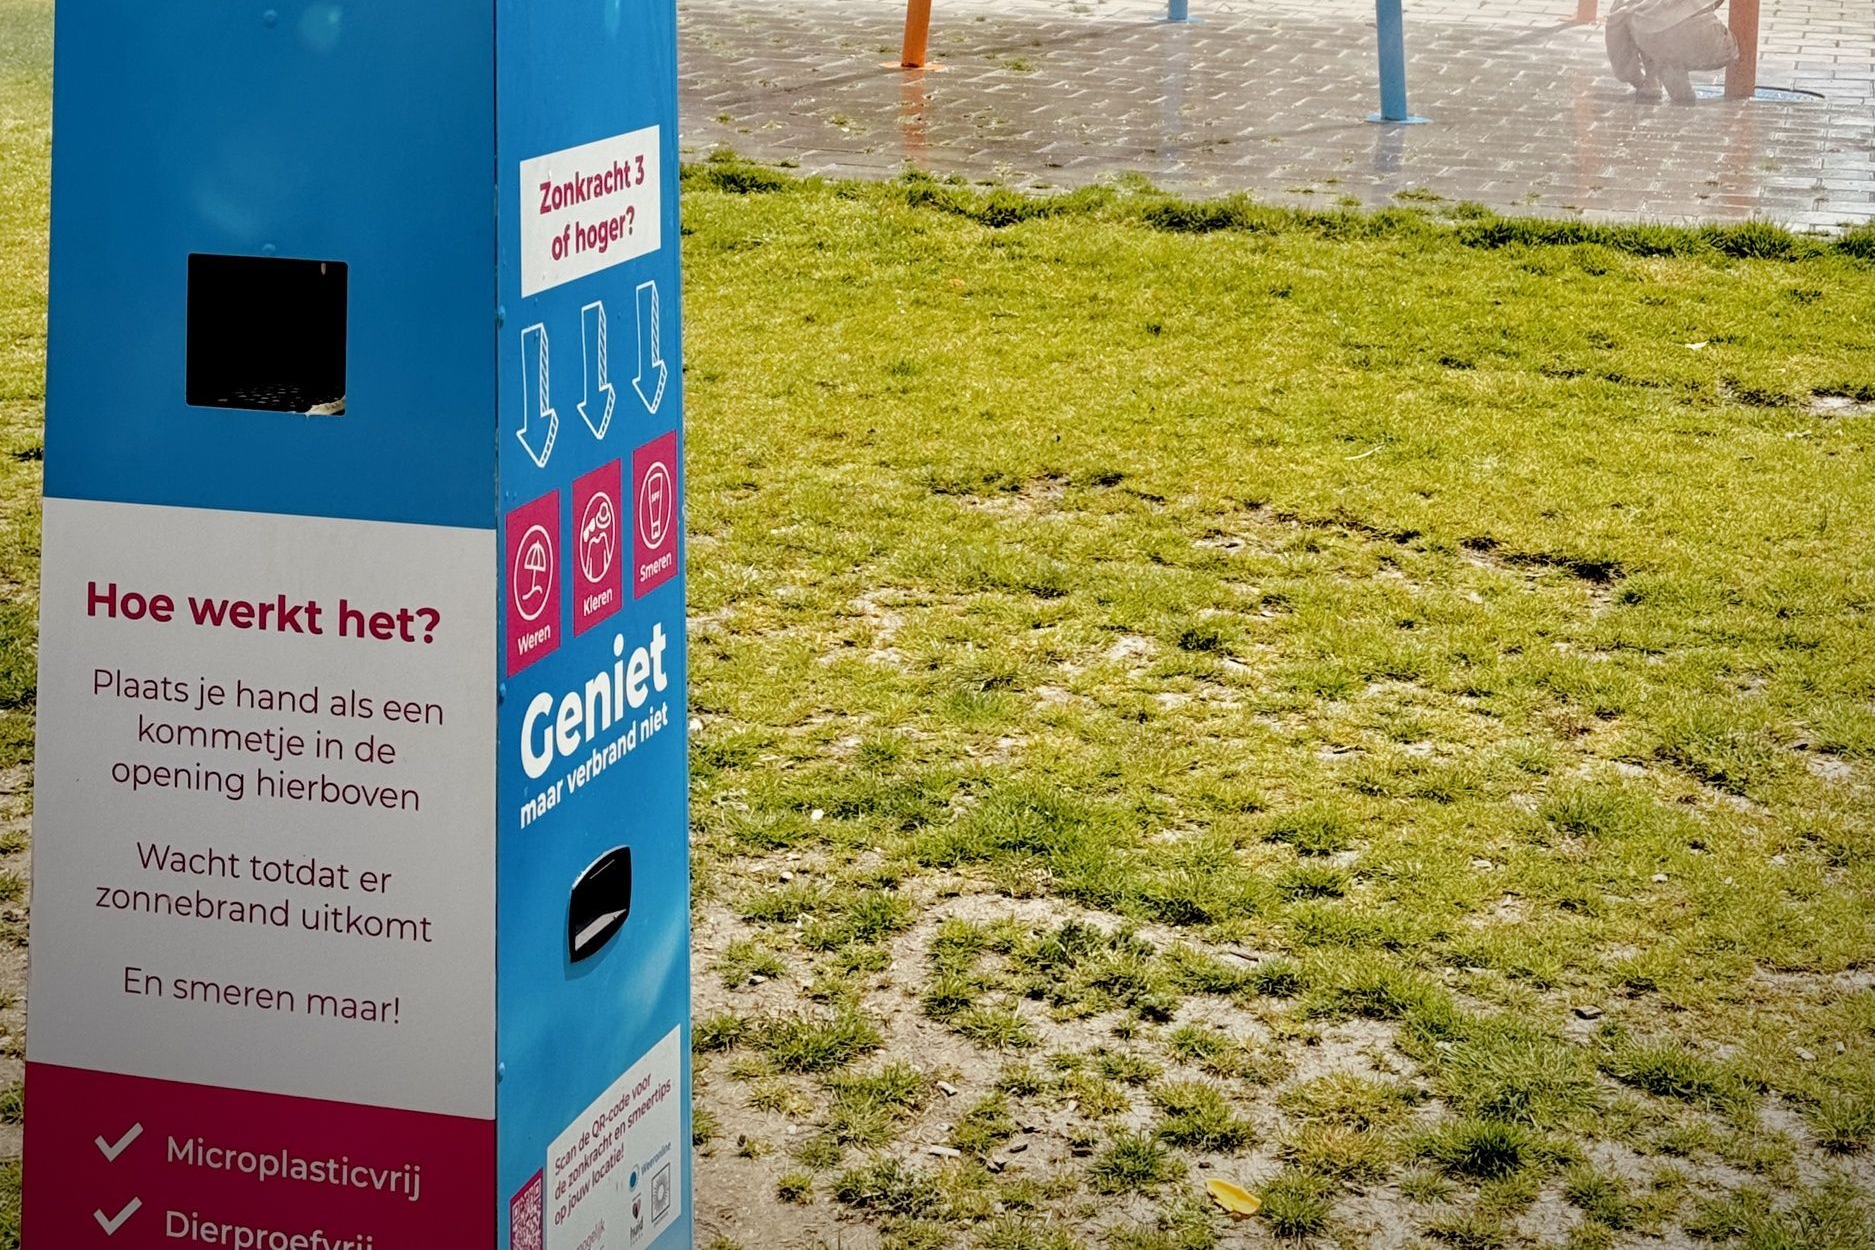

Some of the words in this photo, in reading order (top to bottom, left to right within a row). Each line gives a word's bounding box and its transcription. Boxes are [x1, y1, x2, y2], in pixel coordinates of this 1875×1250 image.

[540, 160, 631, 214] Zonkracht
[635, 154, 645, 186] 3
[551, 224, 571, 261] of
[576, 205, 635, 253] hoger?
[640, 552, 672, 583] Smeren
[87, 581, 174, 622] Hoe
[188, 594, 323, 635] werkt
[339, 599, 441, 644] het?
[583, 587, 613, 616] Kleren
[518, 624, 551, 655] Weren
[94, 669, 189, 702] Plaats
[194, 676, 225, 710] je
[236, 680, 319, 714] hand
[330, 689, 374, 719] als
[383, 700, 444, 725] een
[520, 621, 668, 779] Geniet
[138, 714, 305, 761] kommetje
[316, 730, 343, 760] in
[354, 735, 396, 764] de
[520, 778, 564, 830] maar
[567, 720, 637, 794] verbrand
[640, 701, 668, 743] niet
[111, 762, 245, 801] opening
[257, 768, 419, 811] hierboven
[137, 841, 241, 879] Wacht
[249, 855, 349, 890] totdat
[359, 870, 392, 894] er
[95, 886, 289, 928] zonnebrand
[301, 903, 433, 942] uitkomt
[124, 966, 162, 997] En
[173, 977, 294, 1012] smeren
[307, 992, 400, 1025] maar!
[554, 1144, 577, 1176] Scan
[578, 1131, 590, 1152] de
[591, 1093, 631, 1139] QR-code
[631, 1073, 652, 1100] voor
[554, 1180, 567, 1200] de
[568, 1131, 613, 1188] zonkracht
[614, 1121, 626, 1141] en
[627, 1078, 672, 1129] smeertips
[166, 1135, 421, 1202] Microplasticvrij
[554, 1205, 567, 1226] op
[567, 1180, 591, 1218] jouw
[591, 1142, 625, 1187] locatie!
